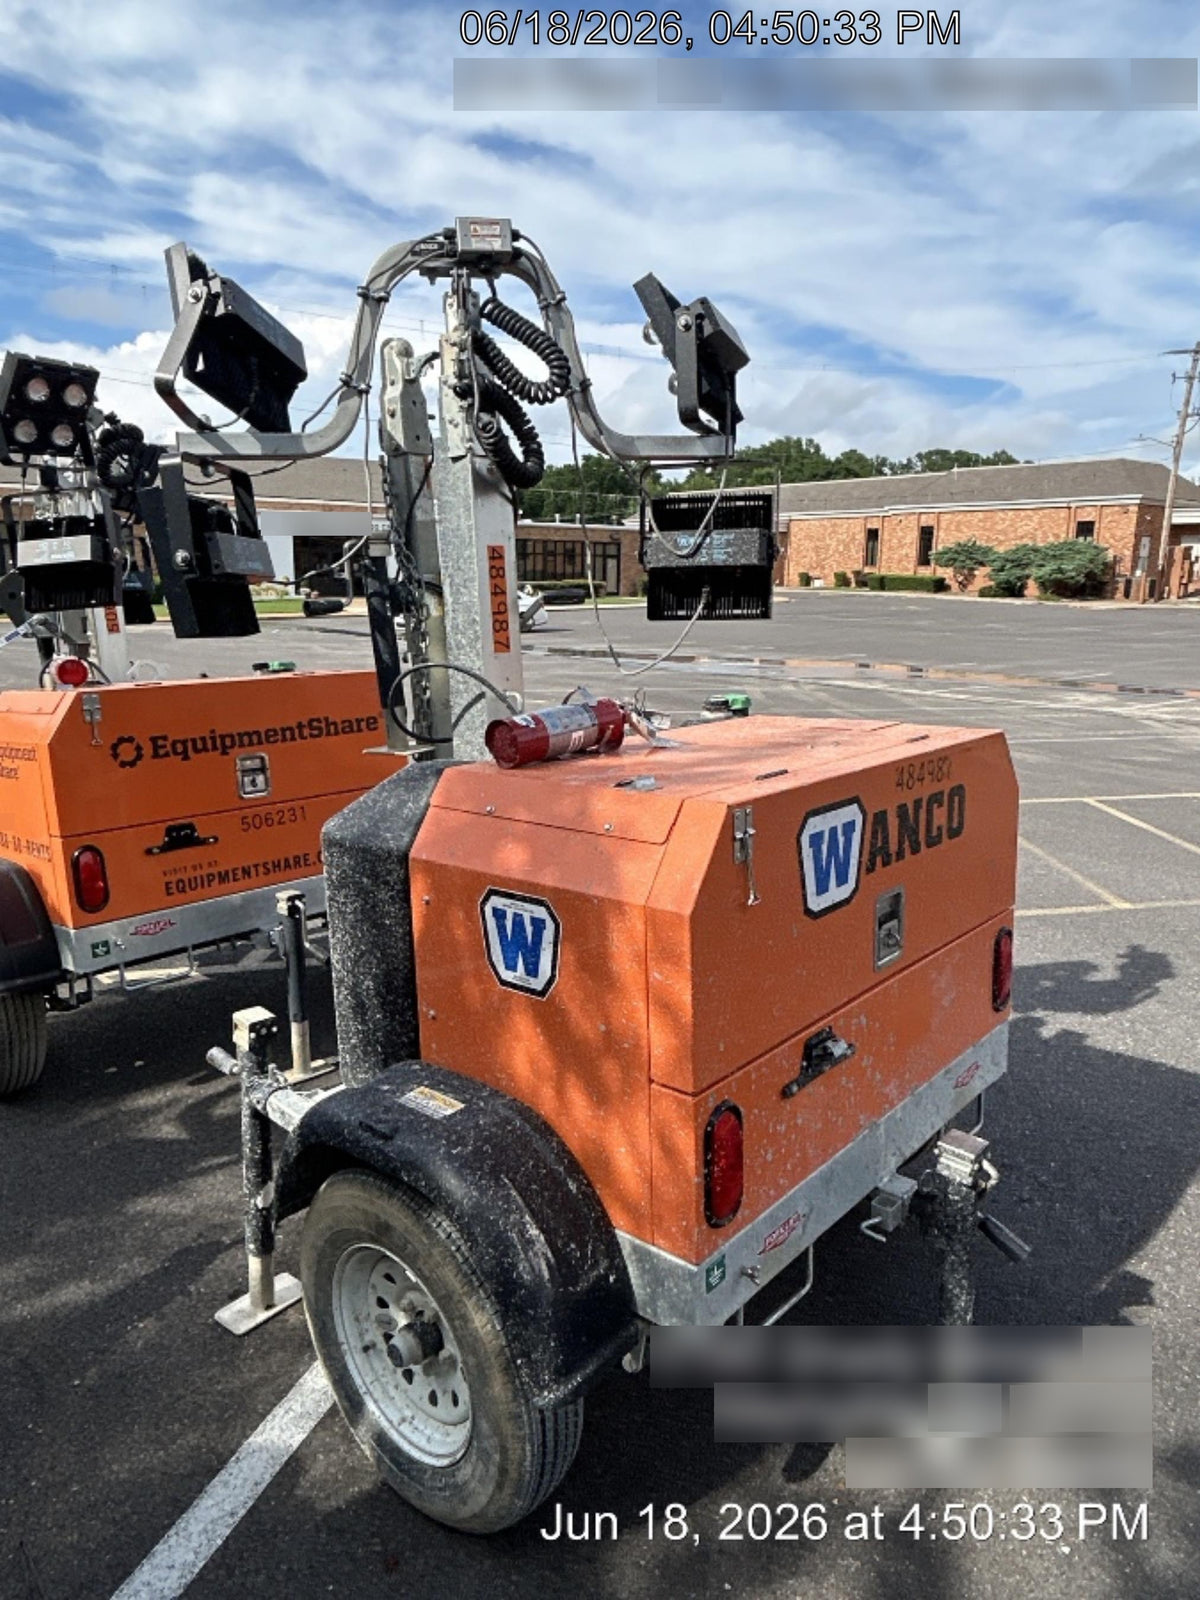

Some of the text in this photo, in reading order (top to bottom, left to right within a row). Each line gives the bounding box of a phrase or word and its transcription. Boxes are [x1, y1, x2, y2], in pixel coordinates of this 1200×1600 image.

[489, 546, 511, 650] 484987
[149, 715, 379, 761] EquipmentShare
[240, 806, 307, 833] 506231
[807, 783, 967, 898] WANCO
[492, 906, 546, 978] W
